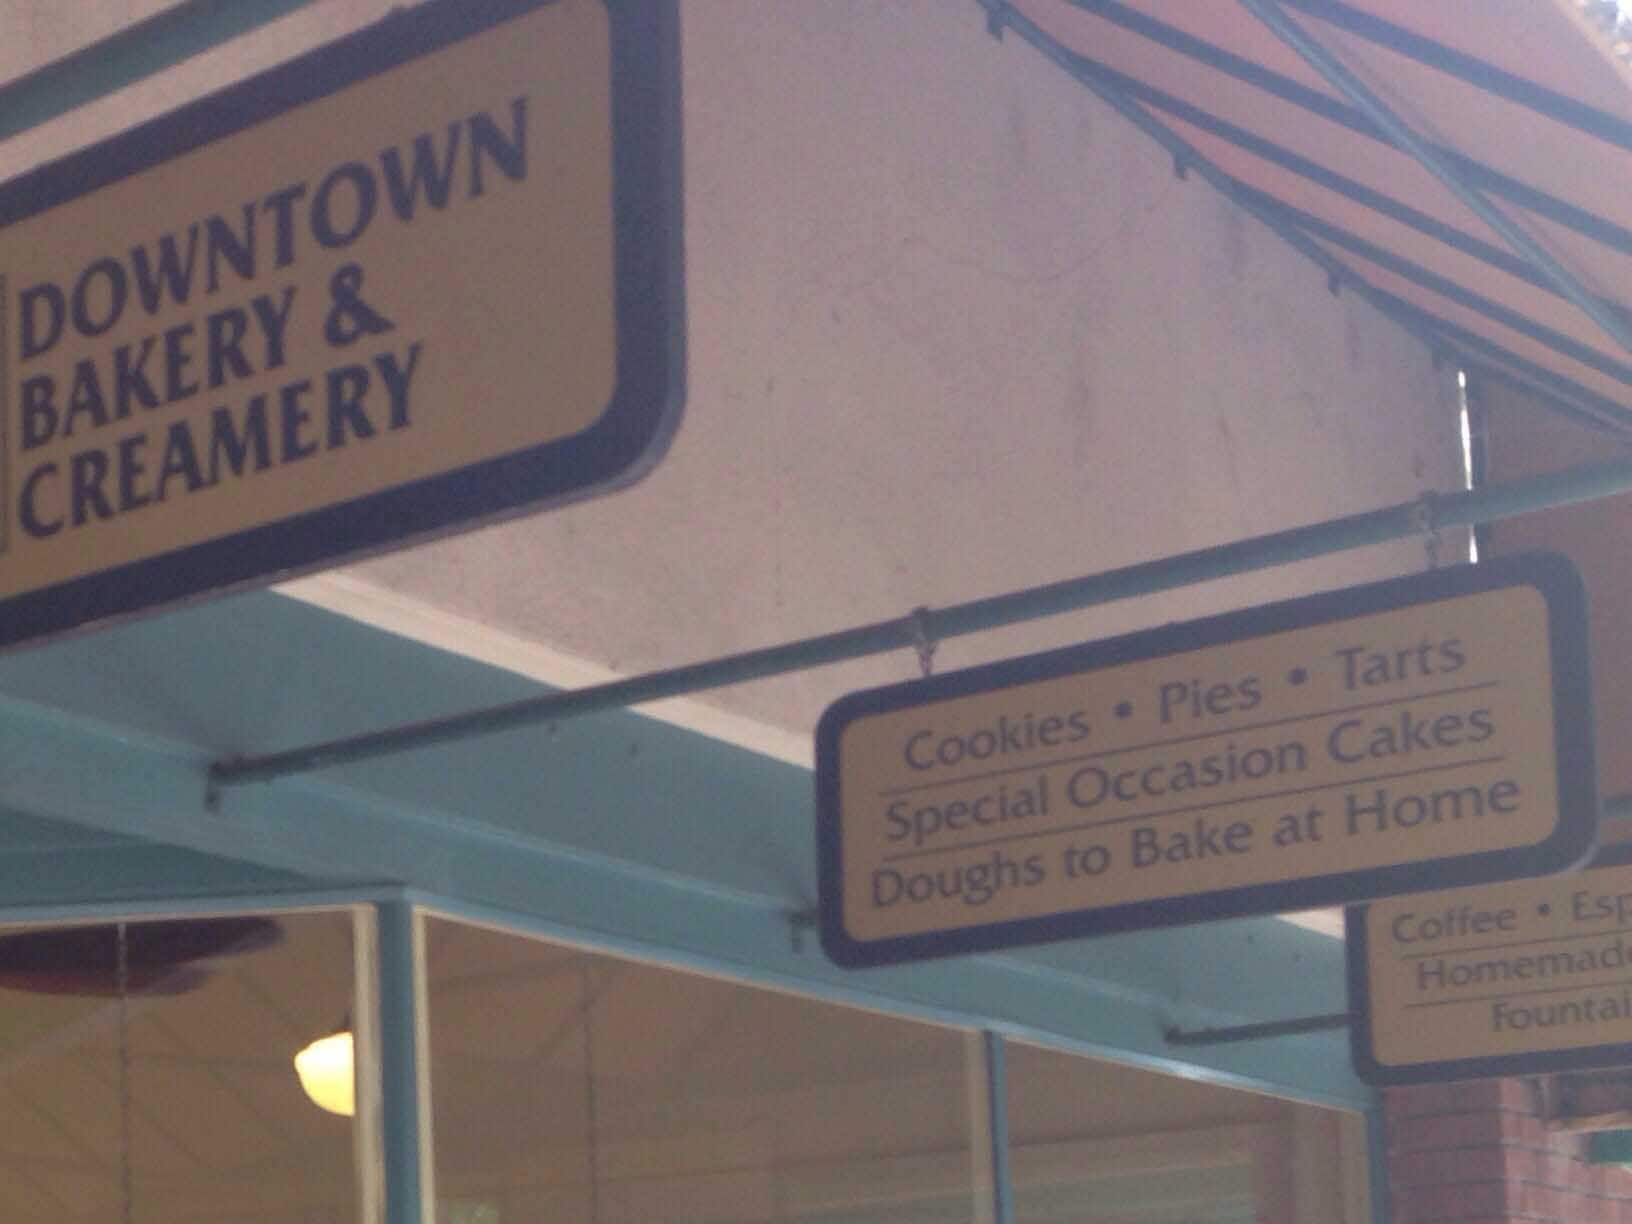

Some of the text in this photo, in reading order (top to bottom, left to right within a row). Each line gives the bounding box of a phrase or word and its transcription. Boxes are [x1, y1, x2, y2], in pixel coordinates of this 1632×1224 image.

[19, 99, 529, 359] DOWNTOWN
[19, 263, 396, 452] BAKERY &
[18, 342, 423, 539] CREAMERY
[904, 638, 1466, 771] Cookies Pies Tarts
[870, 778, 1521, 908] Doughs to Bake at Home
[885, 707, 1495, 846] Special Occasion Cakes
[1392, 906, 1517, 943] Coffee
[1418, 938, 1632, 991] Homemad
